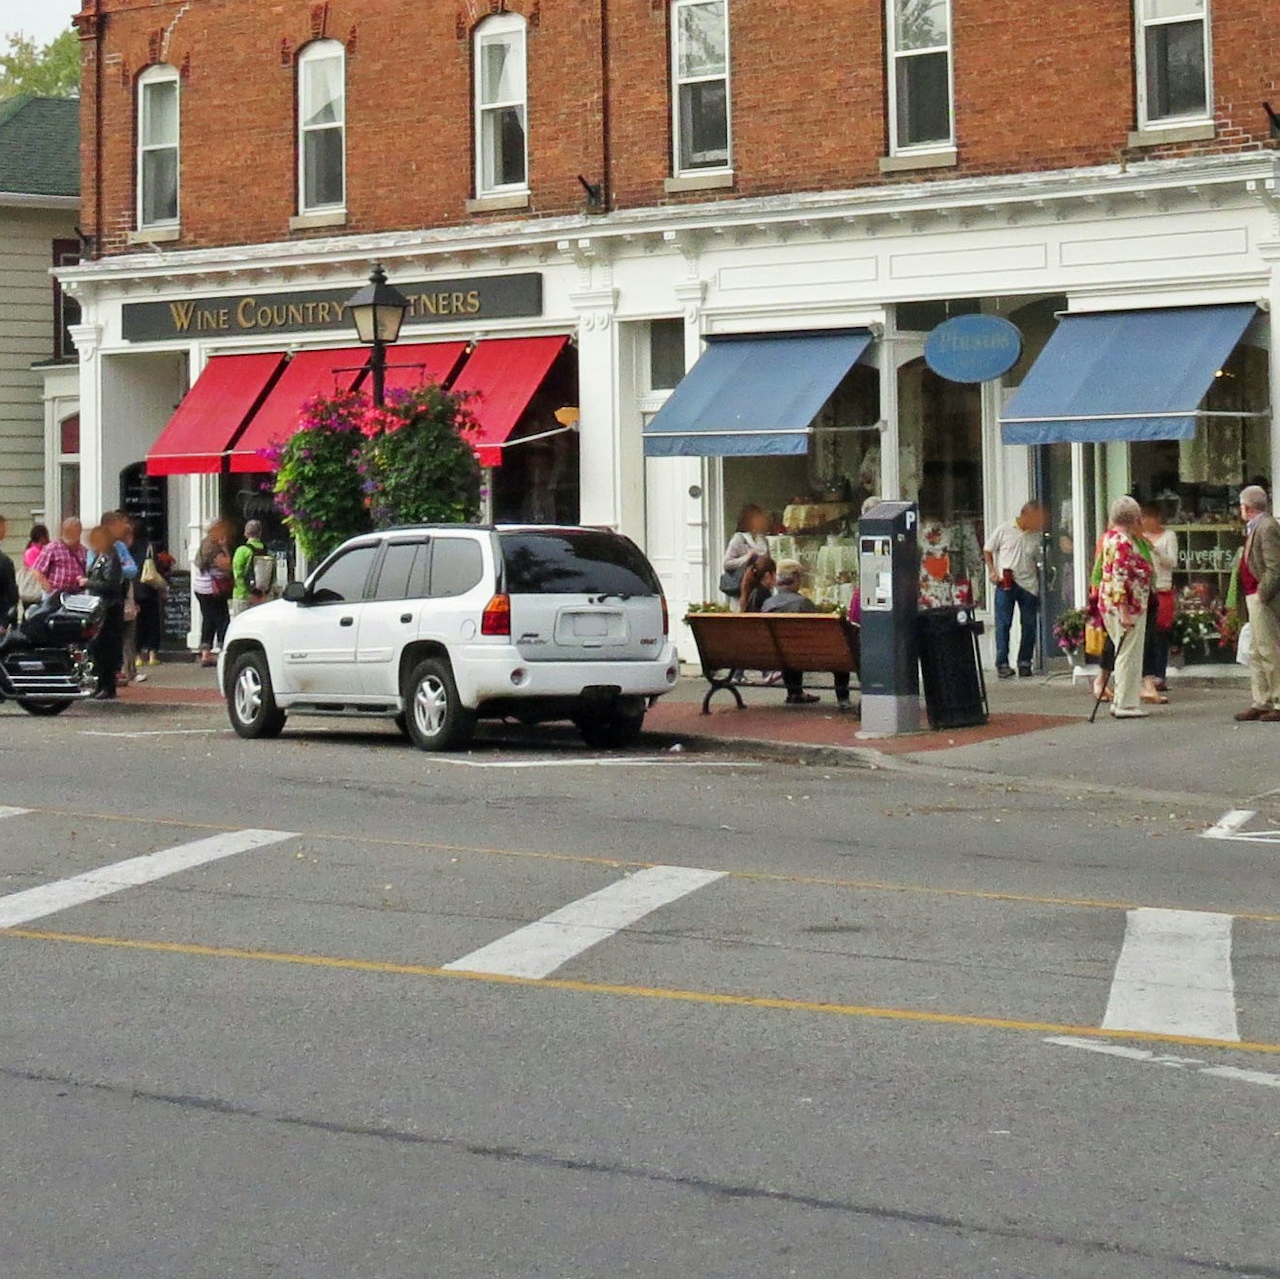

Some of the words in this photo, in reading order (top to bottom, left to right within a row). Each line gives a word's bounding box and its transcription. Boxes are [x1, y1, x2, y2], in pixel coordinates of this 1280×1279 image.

[169, 301, 230, 332] WINE
[237, 297, 349, 329] COUNTRY
[406, 290, 481, 318] TNERS
[905, 511, 916, 530] P
